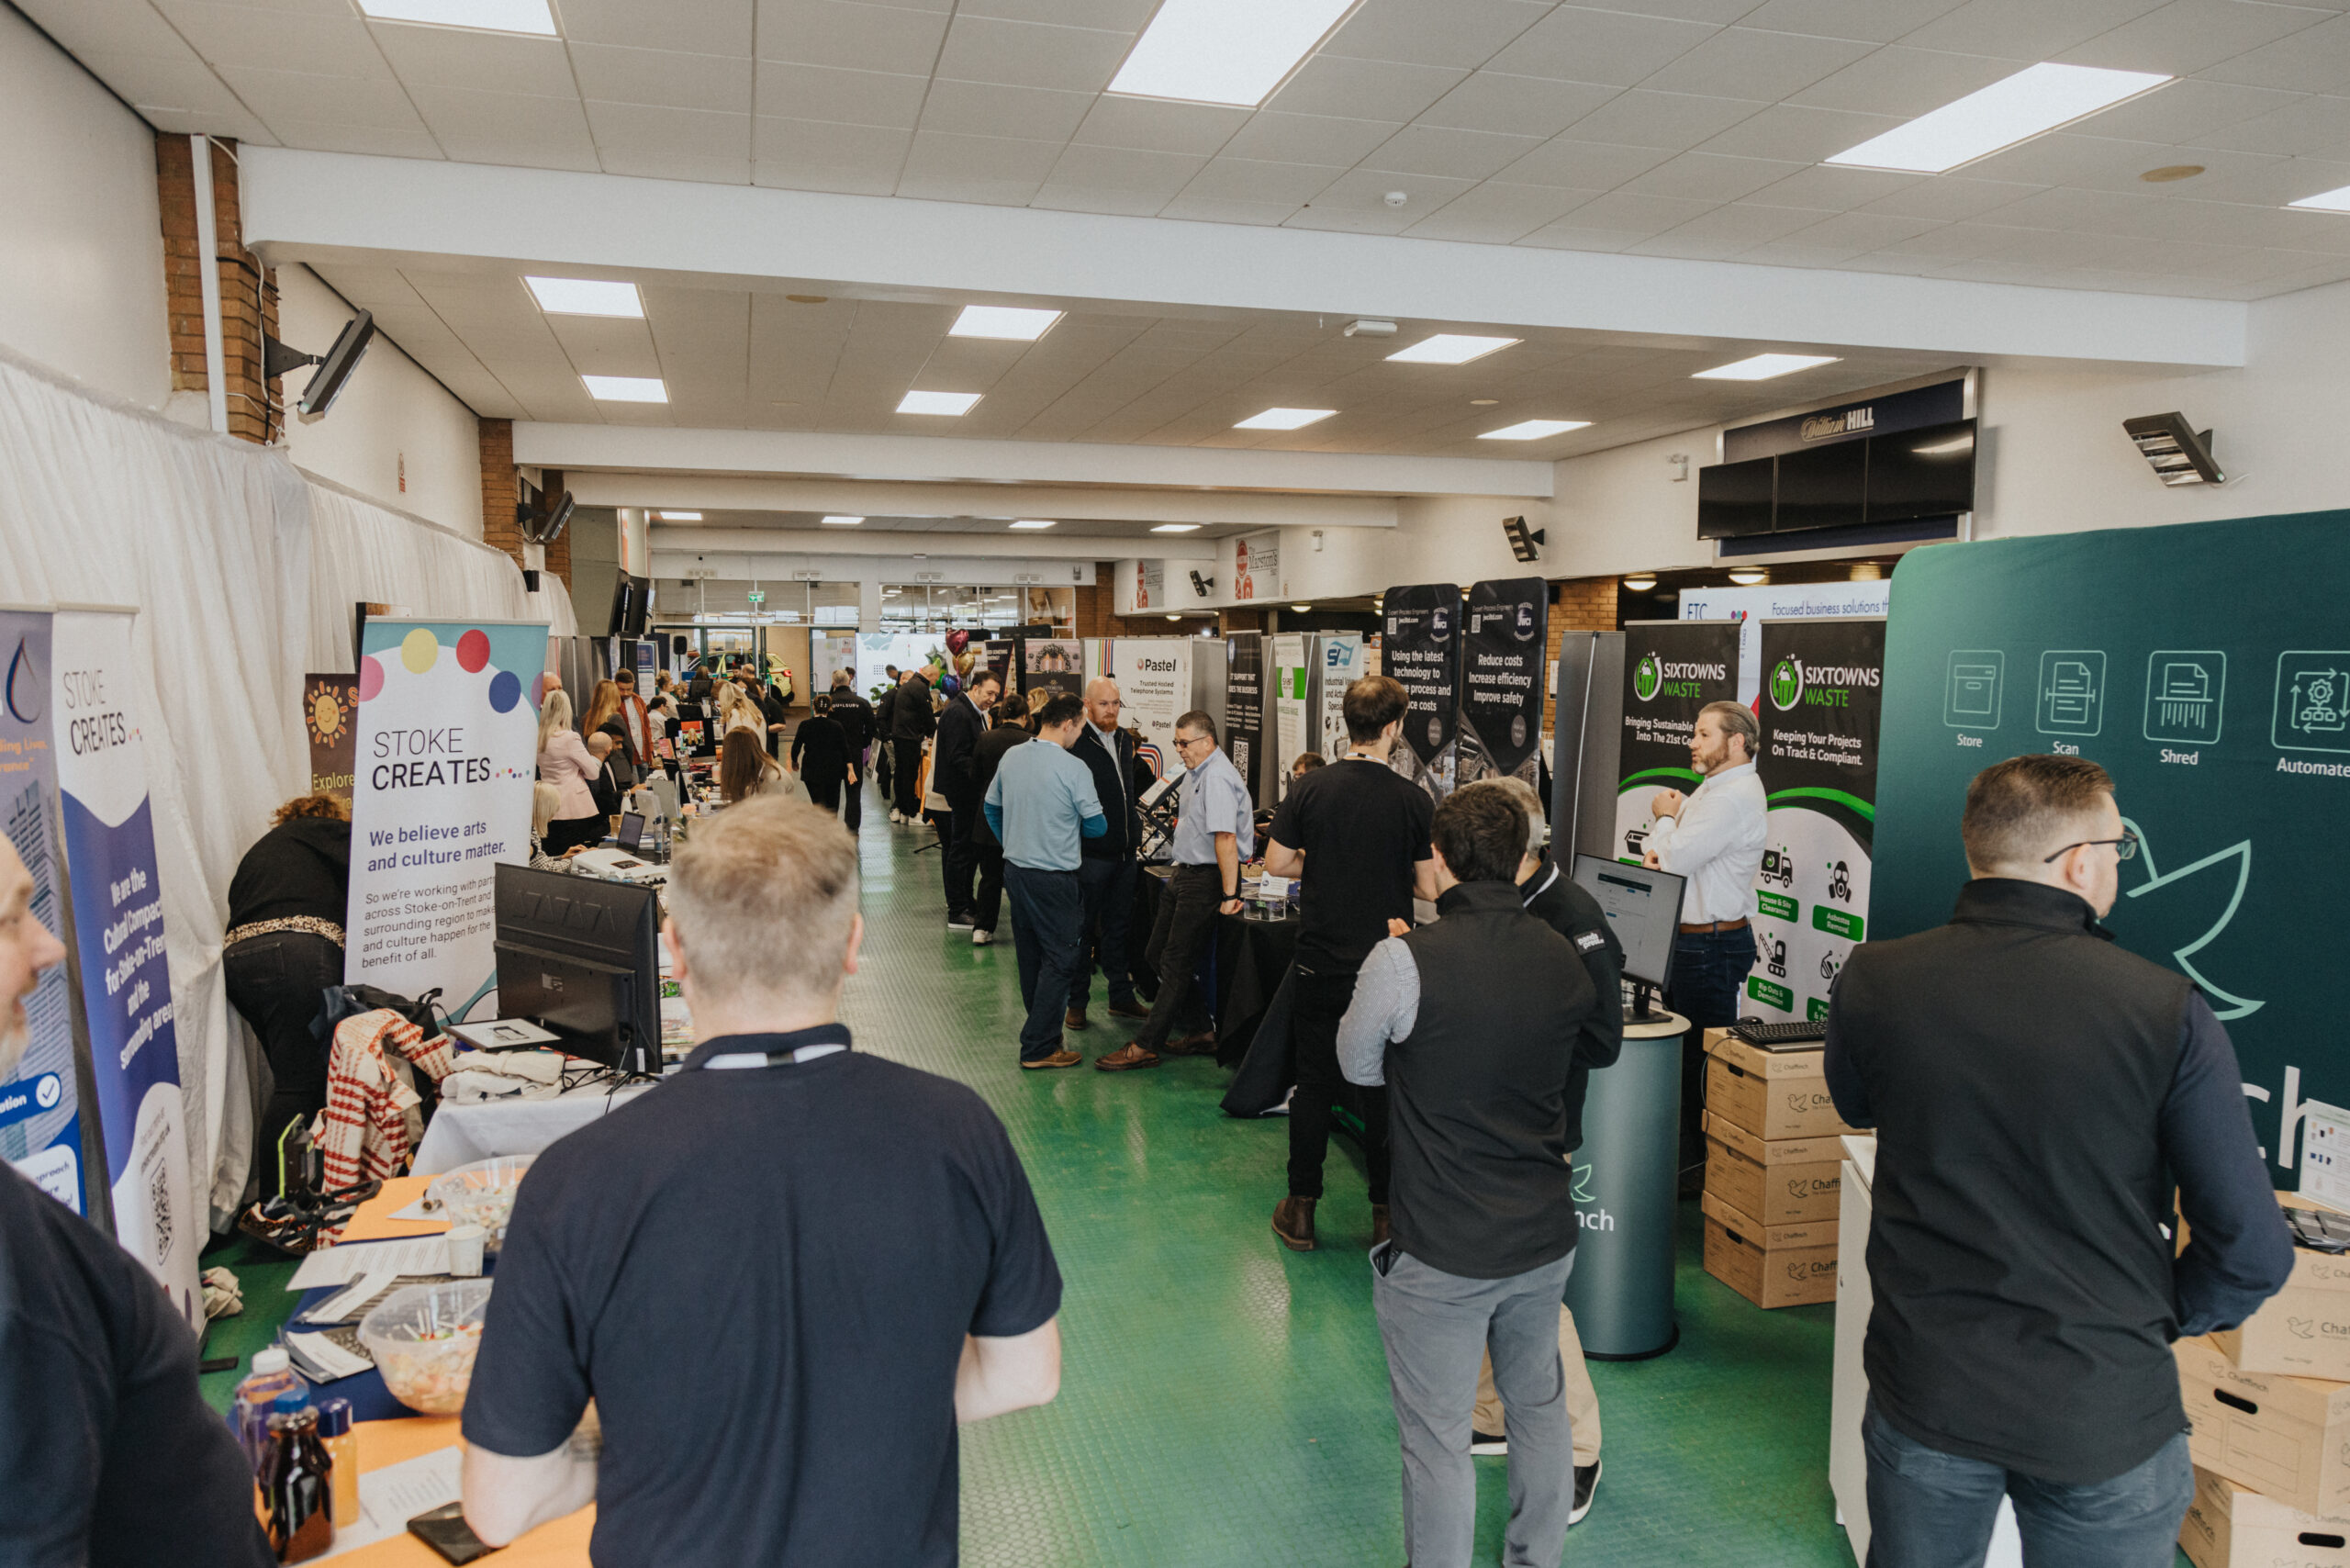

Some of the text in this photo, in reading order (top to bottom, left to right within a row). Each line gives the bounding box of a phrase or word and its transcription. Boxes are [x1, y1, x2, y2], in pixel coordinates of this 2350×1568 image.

[1847, 407, 1874, 430] HILL
[1773, 602, 1804, 616] Focused
[1806, 600, 1840, 615] business
[1841, 599, 1879, 613] solutions
[1145, 659, 1176, 671] Pastel
[1392, 650, 1444, 663] Using the latest
[1479, 654, 1523, 666] Reduce costs
[1393, 666, 1440, 679] technology to
[1663, 662, 1726, 680] SIXTOWNS
[1805, 666, 1880, 687] SIXTOWNS
[63, 669, 106, 709] STOKE
[1469, 672, 1532, 689] Increase efficiency
[347, 687, 359, 708] S
[1410, 685, 1437, 695] process
[1438, 684, 1451, 696] and
[1473, 689, 1524, 707] Improve safety
[1663, 681, 1701, 698] WASTE
[1805, 688, 1850, 707] WASTE
[1328, 700, 1343, 712] Specia
[1419, 700, 1437, 711] costs
[1625, 716, 1694, 732] Bringing Sustainable
[71, 711, 127, 756] CREATES
[1636, 731, 1651, 741] Into
[1652, 733, 1665, 743] The
[1665, 734, 1681, 745] 21st
[1773, 729, 1862, 750] Keeping Your Projects
[1956, 734, 1983, 747] Store
[374, 728, 464, 758] STOKE
[2053, 741, 2079, 755] Scan
[1772, 745, 1863, 766] On Track & Compliant.
[2160, 749, 2199, 766] Shred
[313, 771, 355, 792] Explore
[372, 757, 491, 791] CREATES
[369, 821, 487, 846] We believe arts
[368, 840, 506, 871] and culture matter.
[120, 878, 132, 901] are
[130, 868, 147, 893] the
[365, 892, 379, 904] So
[382, 887, 410, 901] we're
[414, 883, 458, 898] working
[460, 879, 476, 891] with
[364, 890, 492, 921] across Stoke-on-Trent and
[1760, 894, 1777, 904] House
[1762, 902, 1789, 916] Clearances
[364, 903, 496, 936] surrounding region to make
[1827, 913, 1851, 926] Asbestos
[1827, 921, 1850, 934] Removal
[363, 918, 491, 953] and culture happen for the
[362, 946, 437, 969] benefit of all.
[106, 967, 120, 996] for
[1758, 981, 1767, 991] Rip
[1768, 985, 1779, 995] Outs
[1757, 990, 1784, 1005] Demolition
[1784, 1062, 1808, 1070] Chaffinch
[1812, 1094, 1835, 1104] Cha
[1784, 1147, 1808, 1156] Chaffinch
[1812, 1178, 1841, 1190] Chaffi
[1574, 1208, 1615, 1231] nch
[1811, 1260, 1838, 1272] Chaff
[2333, 1269, 2350, 1279] Cha
[2227, 1372, 2269, 1393] Chaffinch
